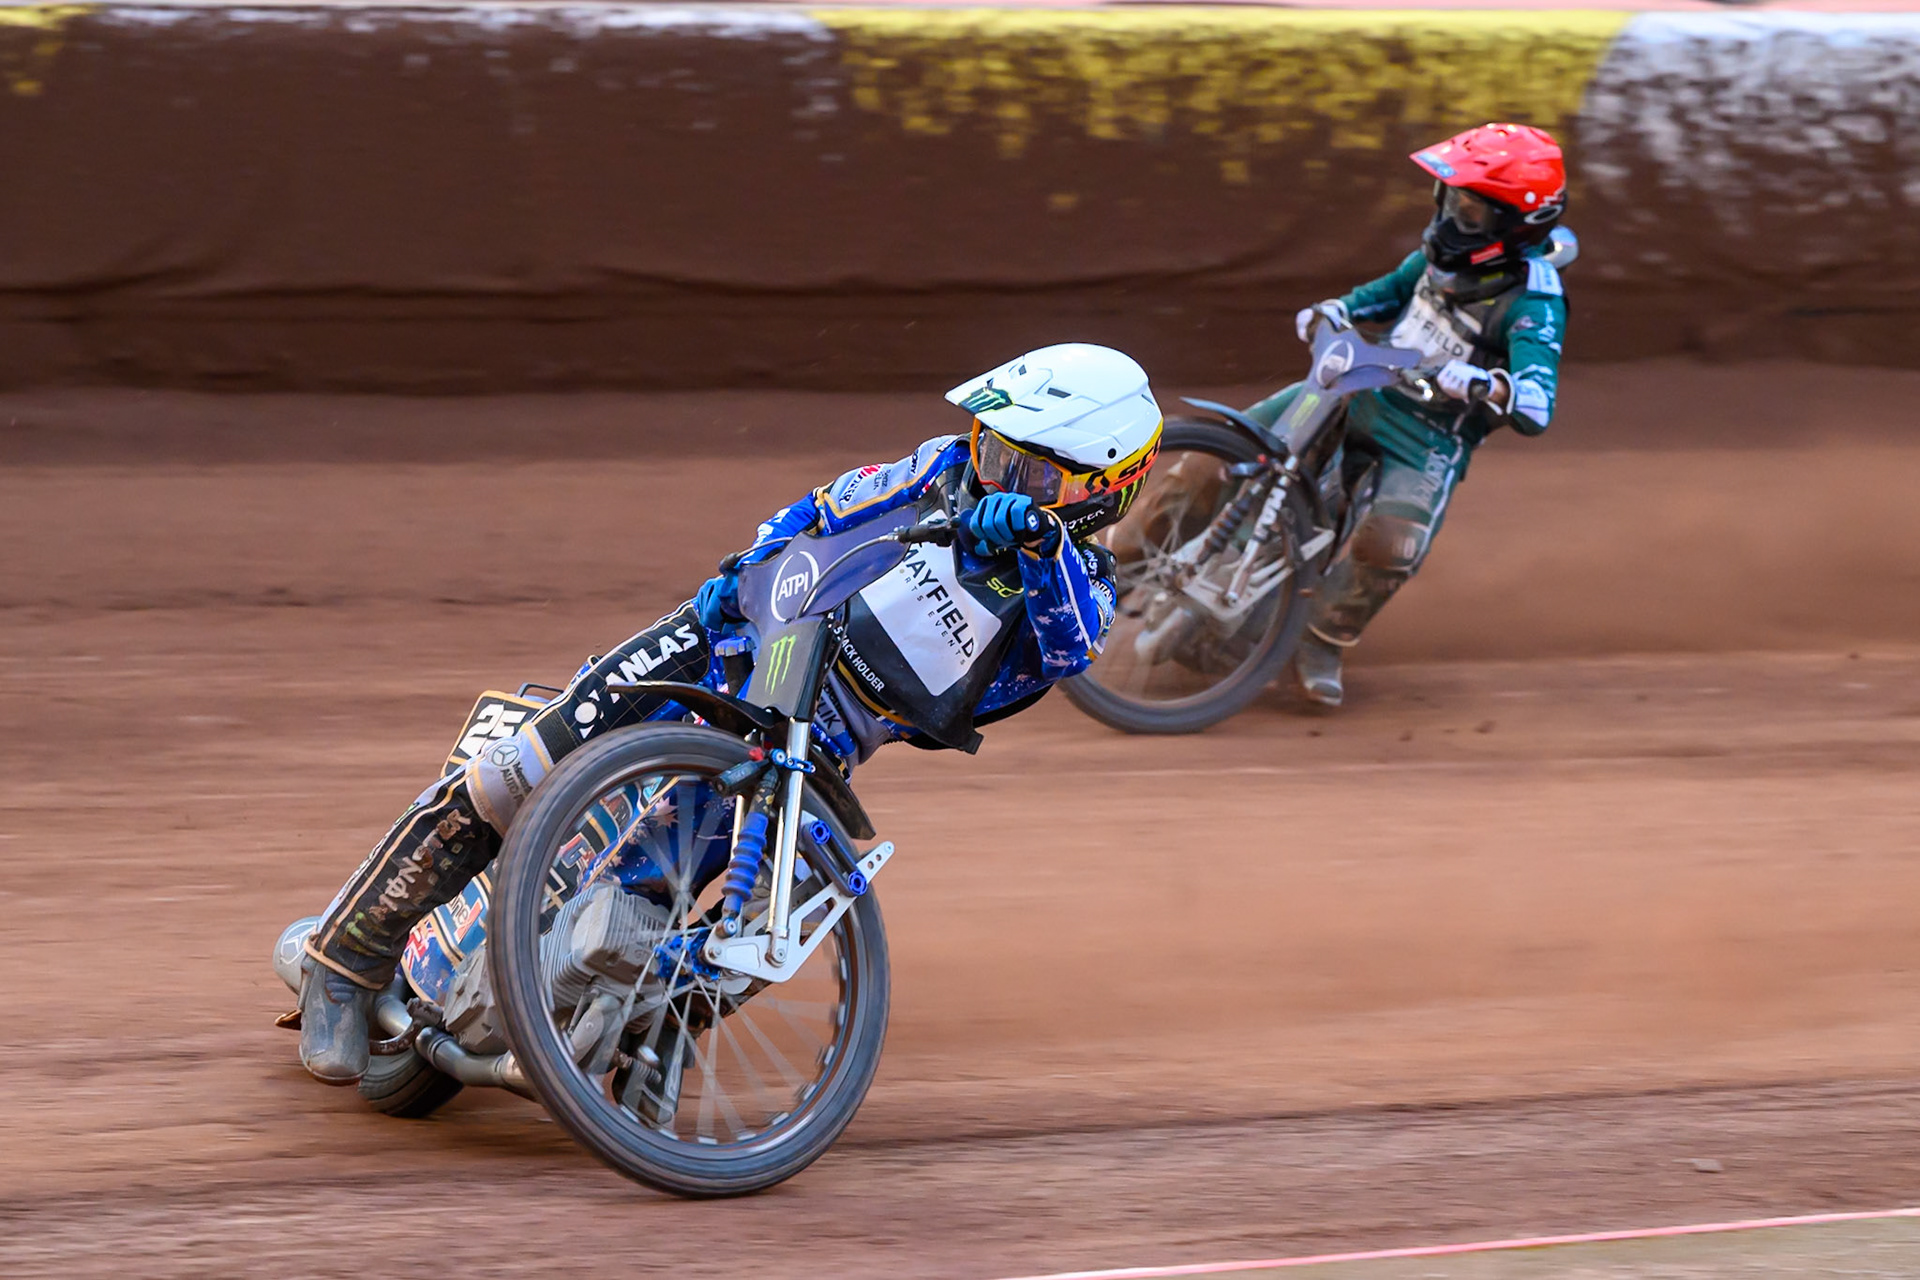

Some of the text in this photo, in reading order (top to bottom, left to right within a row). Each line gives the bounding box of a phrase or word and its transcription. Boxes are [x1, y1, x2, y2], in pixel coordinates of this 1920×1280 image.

[1420, 319, 1465, 357] FIELD
[777, 571, 809, 602] ATPI
[927, 610, 967, 666] EVENTS
[605, 623, 699, 704] ANLAS
[852, 655, 886, 693] HOLDER
[458, 703, 528, 759] 25
[815, 700, 842, 730] LIK
